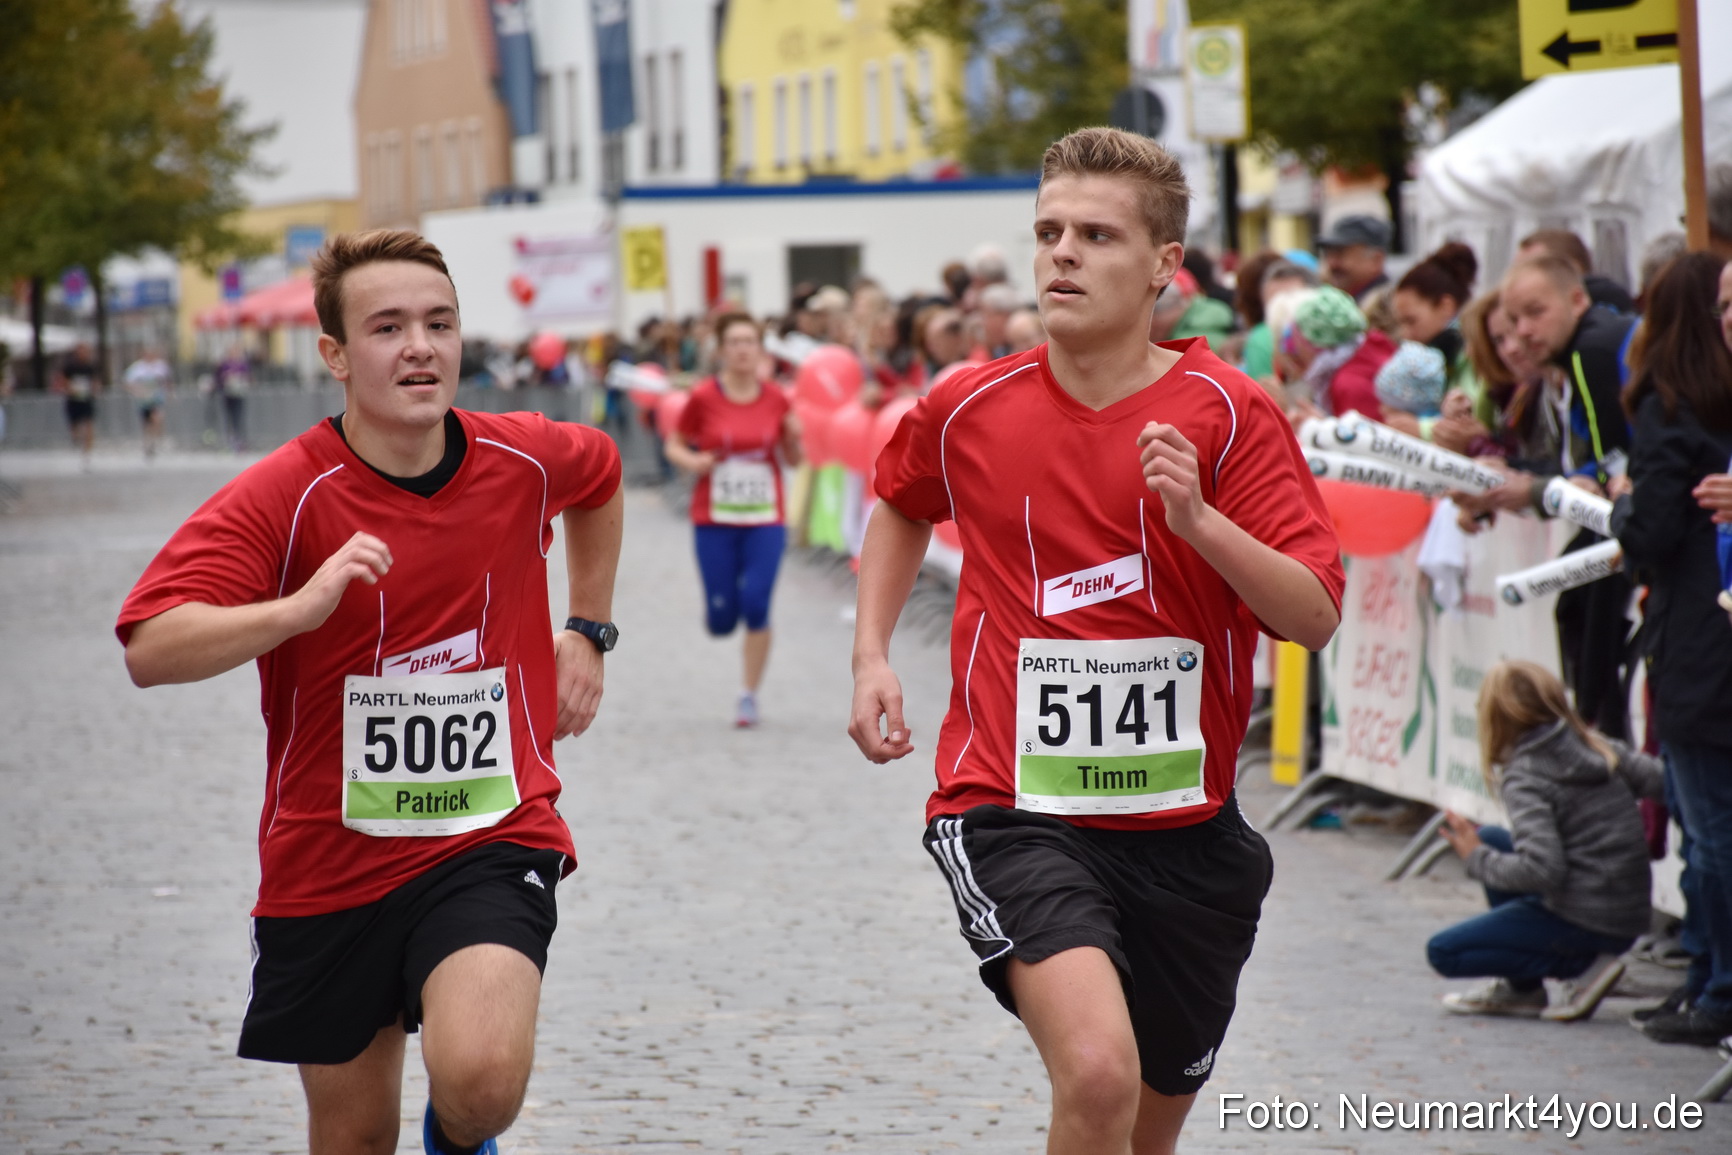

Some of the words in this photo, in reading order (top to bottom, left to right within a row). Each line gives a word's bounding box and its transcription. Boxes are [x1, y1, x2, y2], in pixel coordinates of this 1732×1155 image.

[1071, 572, 1115, 599] DEHN
[408, 647, 453, 675] DEHN
[1022, 656, 1081, 674] PARTL
[1085, 656, 1170, 674] Neumarkt
[349, 691, 409, 707] PARTL
[413, 688, 486, 707] Neumarkt
[1037, 679, 1179, 747] 5141
[364, 710, 498, 774] 5062
[1025, 742, 1033, 753] S
[351, 769, 359, 780] S
[1077, 765, 1148, 790] Timm
[396, 788, 470, 814] Patrick
